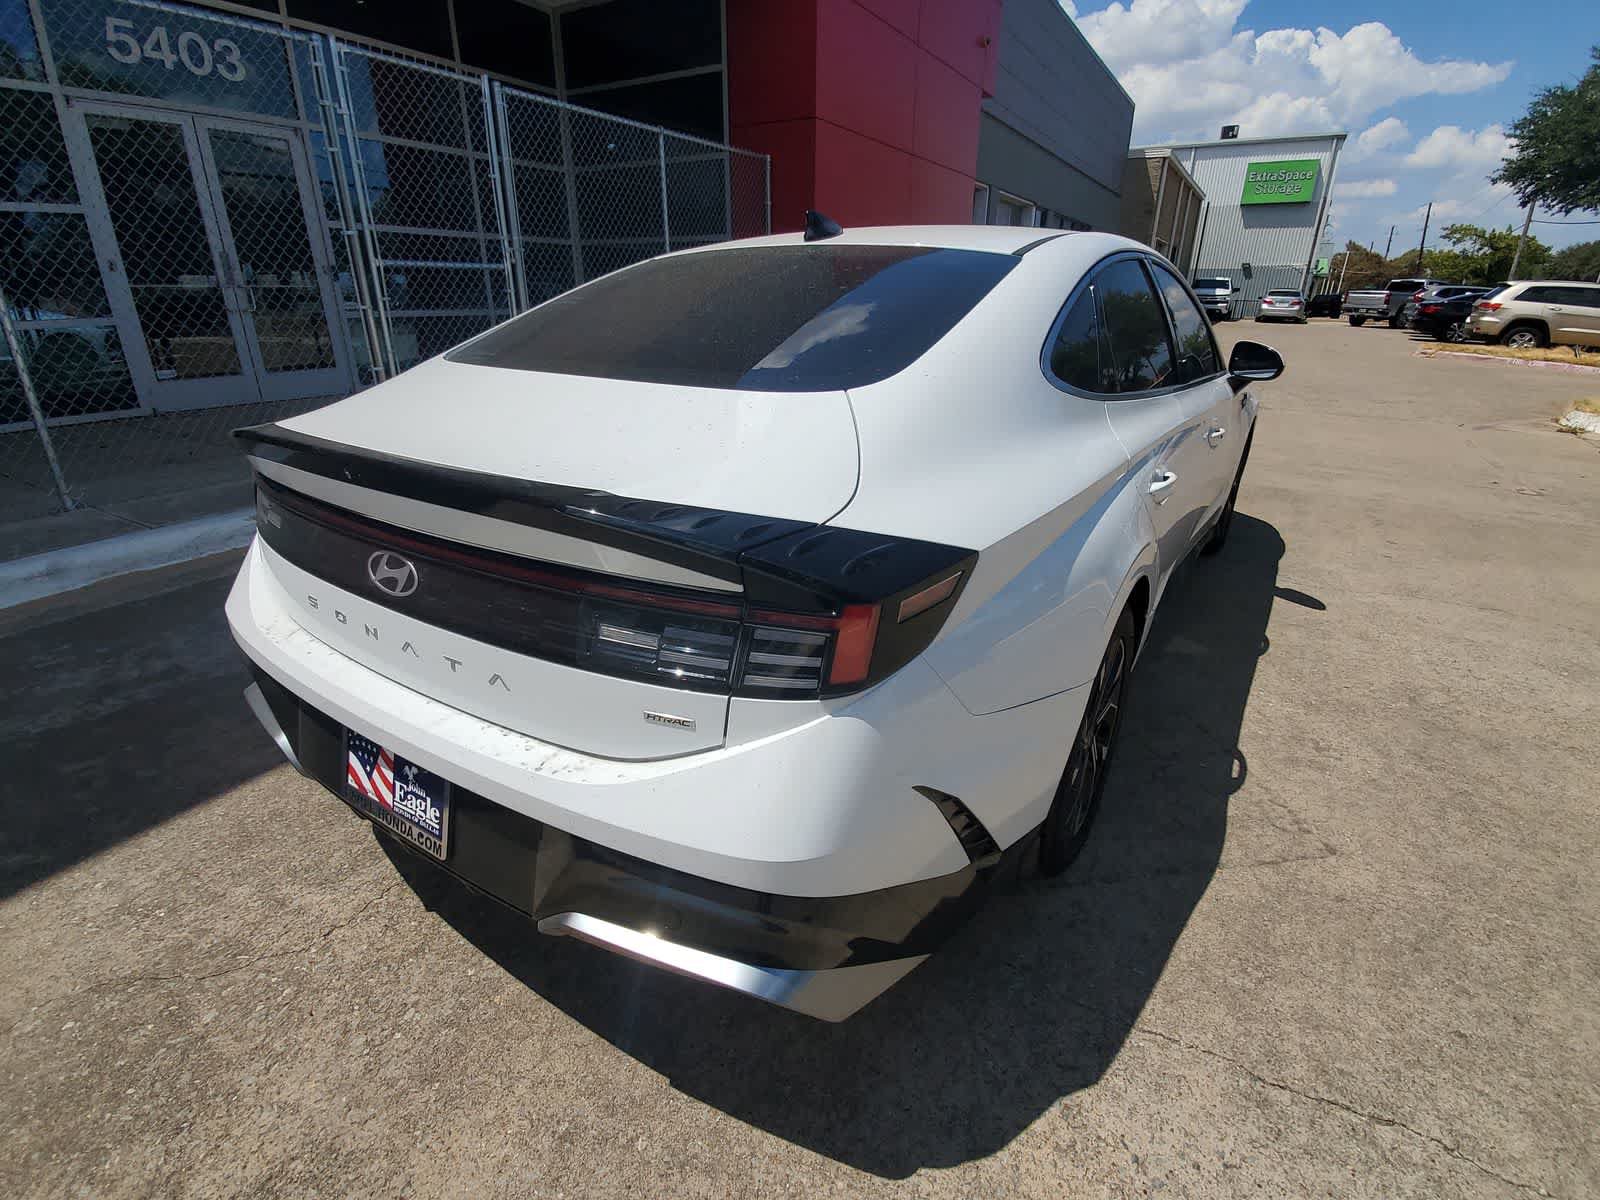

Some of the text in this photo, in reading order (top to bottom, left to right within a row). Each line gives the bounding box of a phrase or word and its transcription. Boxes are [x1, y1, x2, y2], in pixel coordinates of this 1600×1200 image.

[105, 16, 247, 82] 5403
[1255, 183, 1302, 195] Storage
[307, 595, 511, 692] SONATA
[394, 780, 440, 823] Eagle
[406, 782, 426, 797] John
